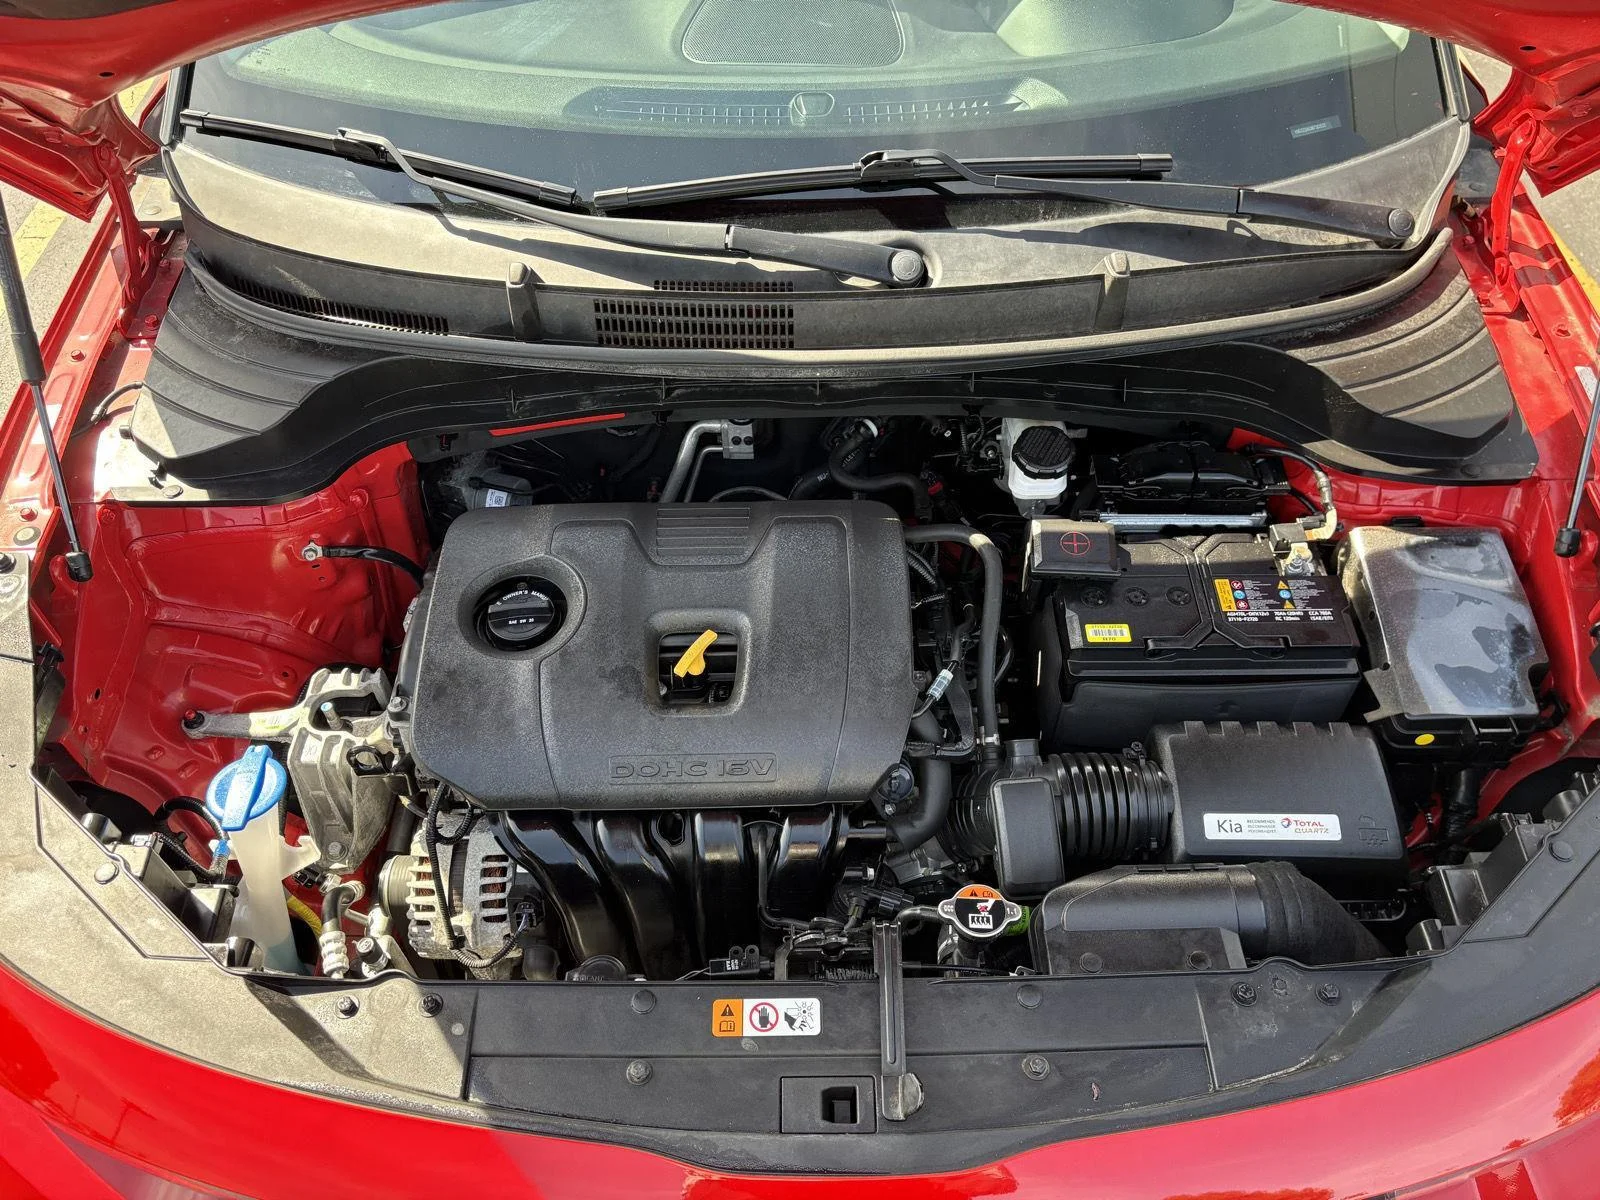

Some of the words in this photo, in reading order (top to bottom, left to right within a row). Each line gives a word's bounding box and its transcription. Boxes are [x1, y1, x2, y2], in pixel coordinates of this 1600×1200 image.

[502, 590, 529, 601] OWNER'S
[611, 761, 708, 779] DOHC
[718, 758, 775, 777] 16V
[1216, 819, 1243, 834] Kia
[1294, 819, 1325, 827] TOTAL
[1006, 907, 1017, 915] 1.1
